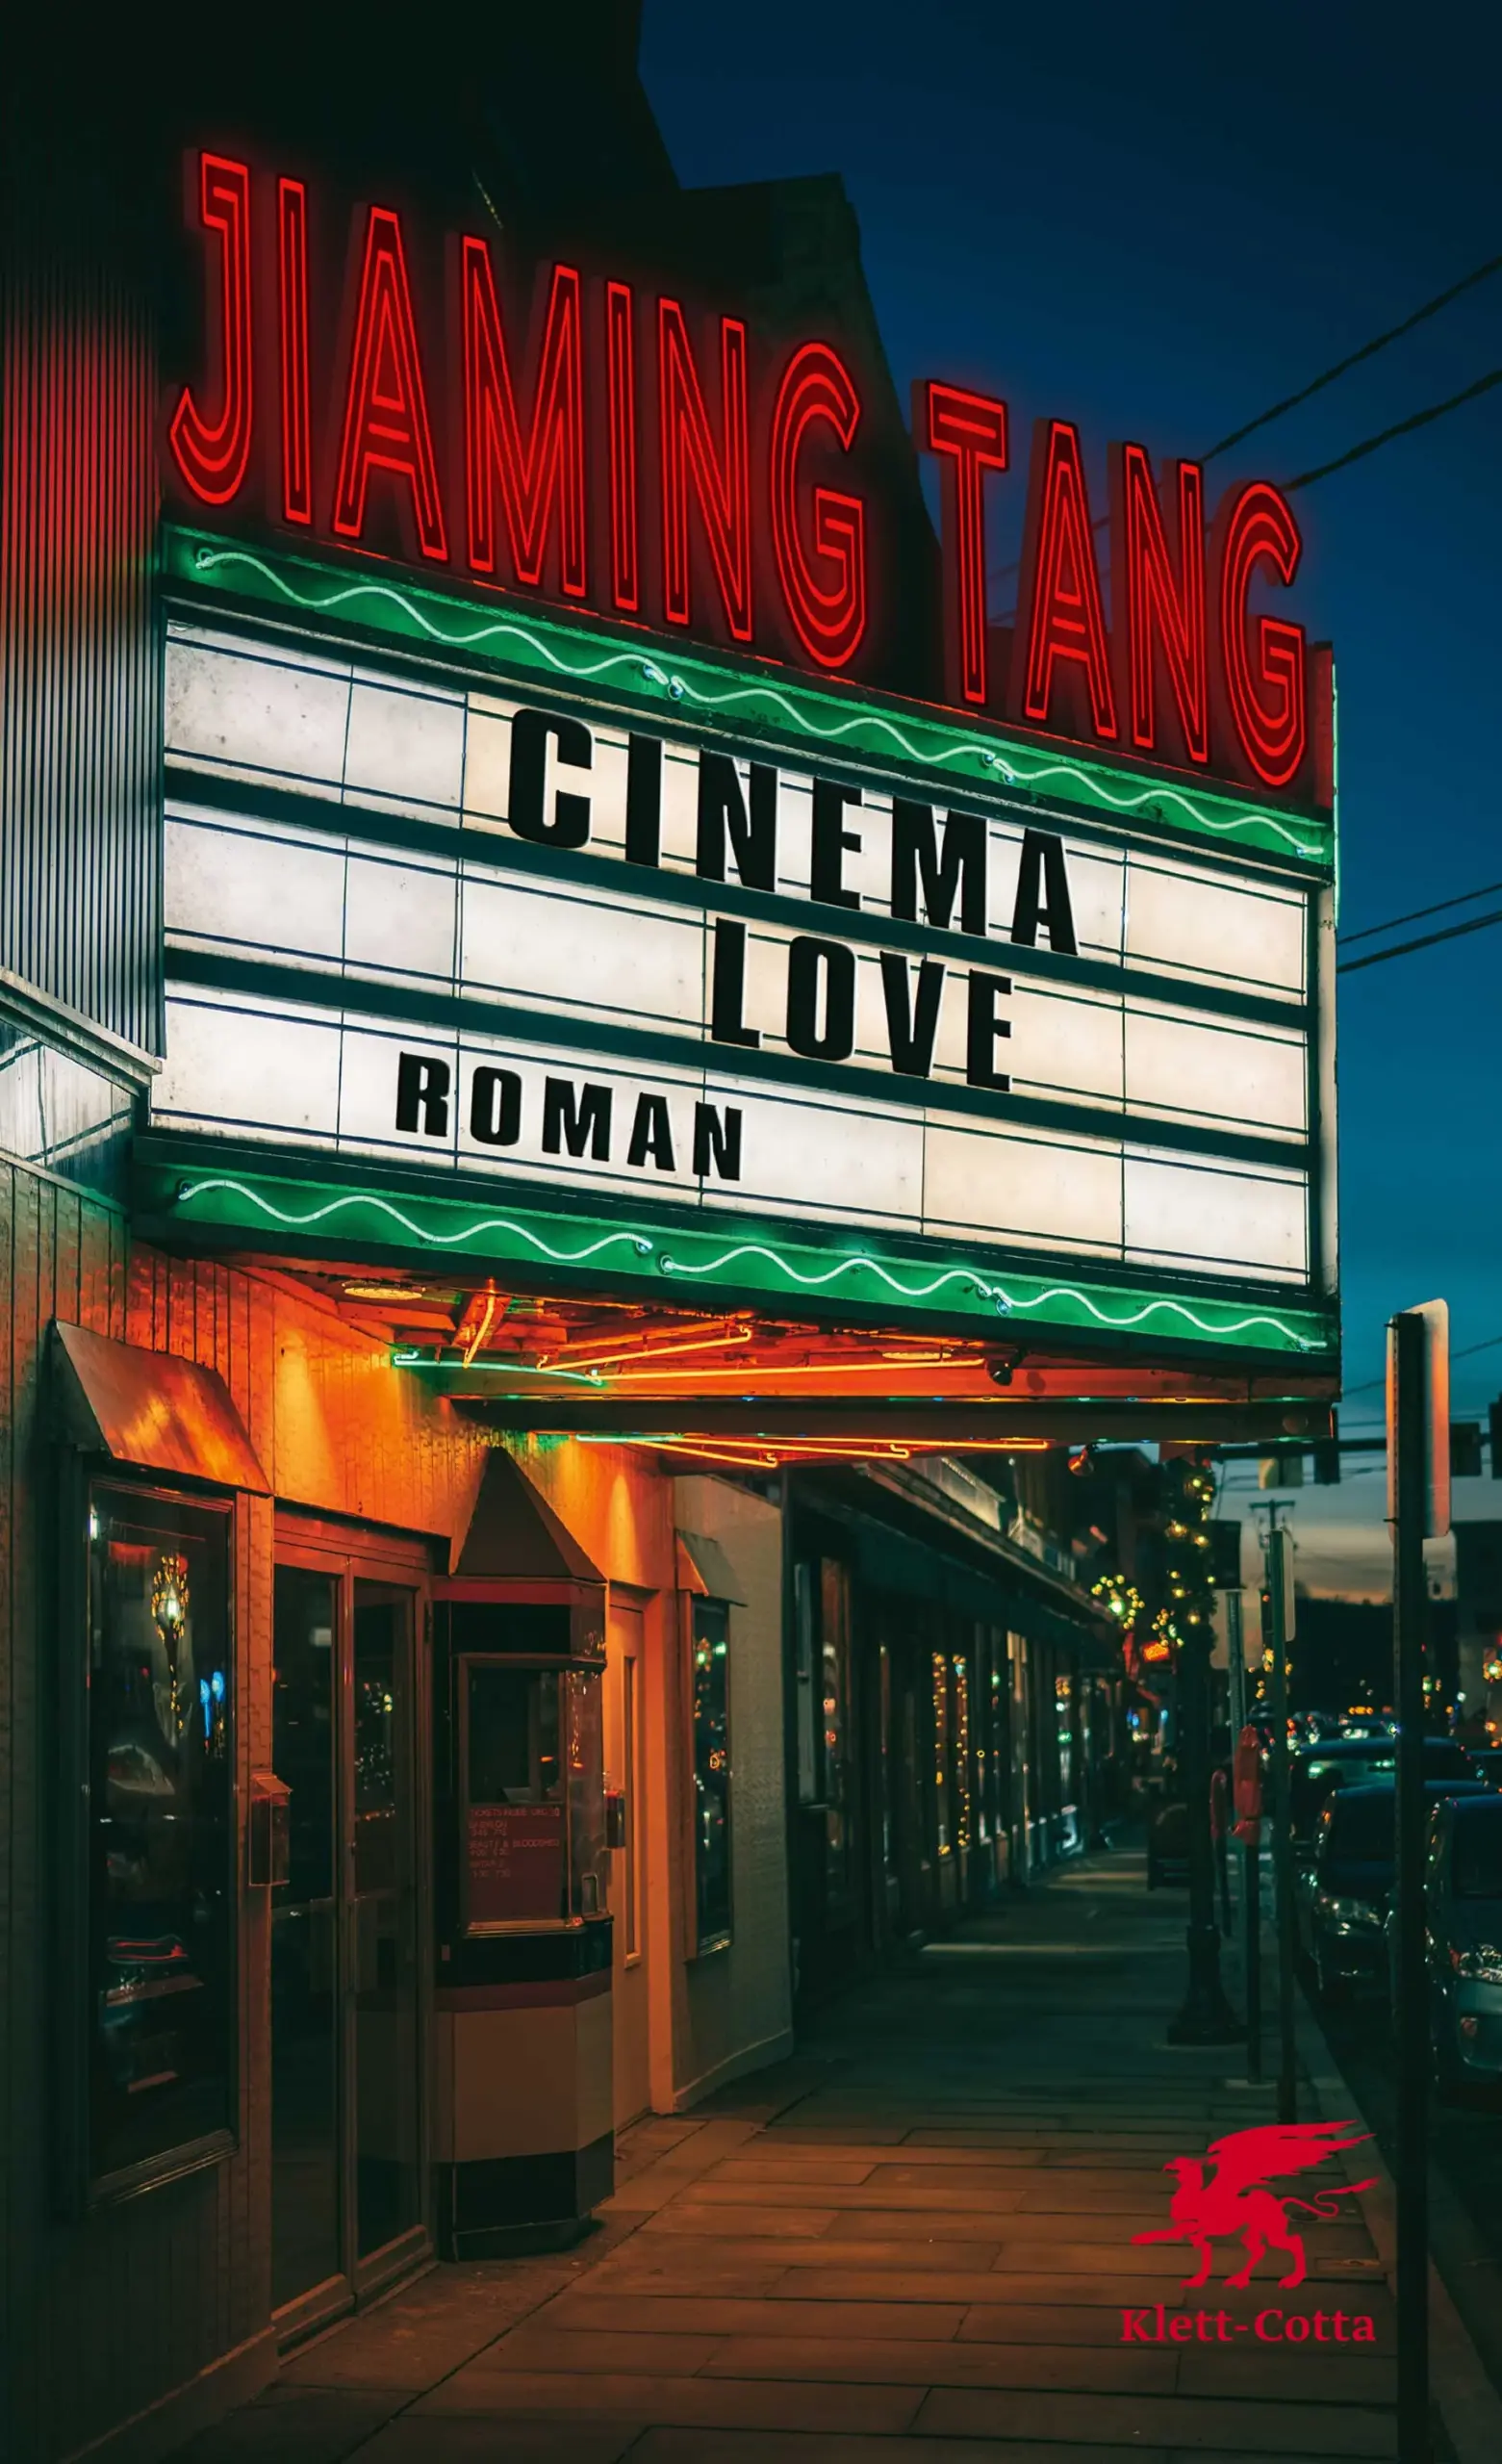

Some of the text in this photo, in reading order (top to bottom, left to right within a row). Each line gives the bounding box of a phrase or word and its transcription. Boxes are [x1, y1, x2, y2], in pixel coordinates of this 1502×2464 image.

[168, 150, 1308, 787] JIAMING TANG
[507, 707, 1080, 956] CINEMA
[712, 917, 1014, 1092] LOVE
[395, 1051, 743, 1182] ROMAN
